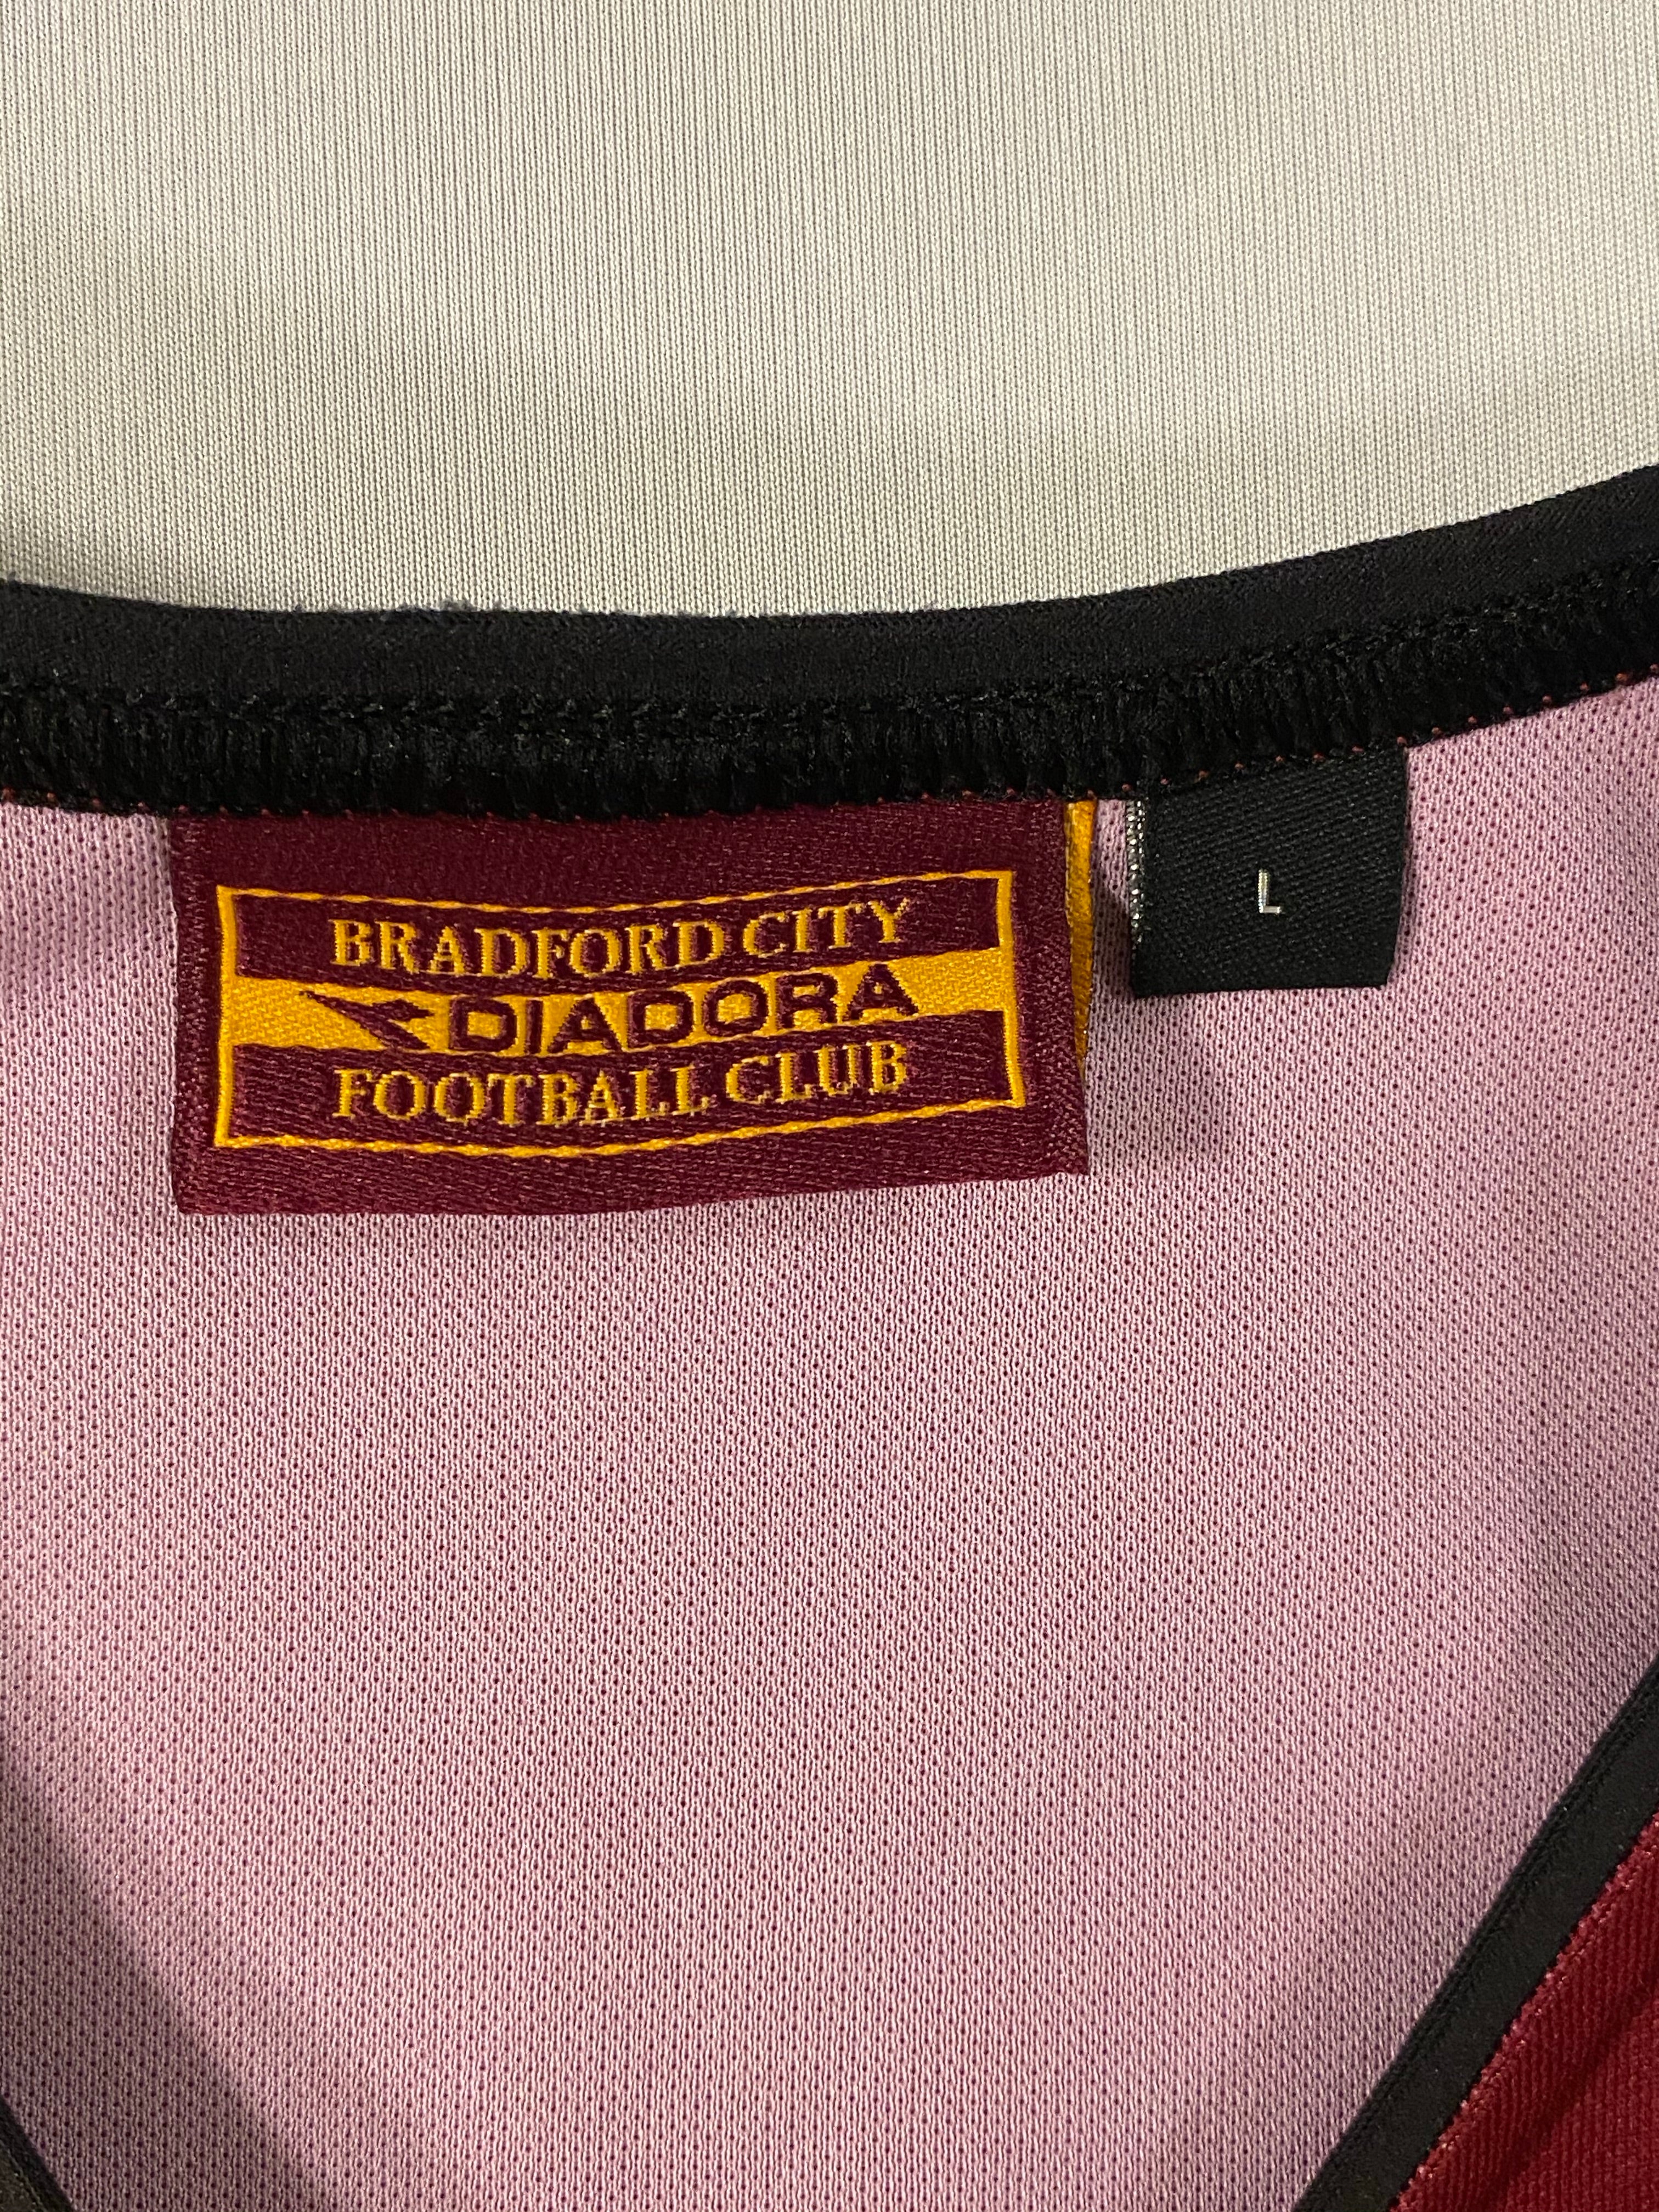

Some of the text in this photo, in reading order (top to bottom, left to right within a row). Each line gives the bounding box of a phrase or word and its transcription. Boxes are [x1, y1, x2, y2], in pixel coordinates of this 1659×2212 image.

[1257, 868, 1282, 914] L
[331, 899, 913, 977] BRADFORD CITY
[448, 963, 919, 1054] DIADORA
[332, 1040, 909, 1126] FOOTBALL CLUB
